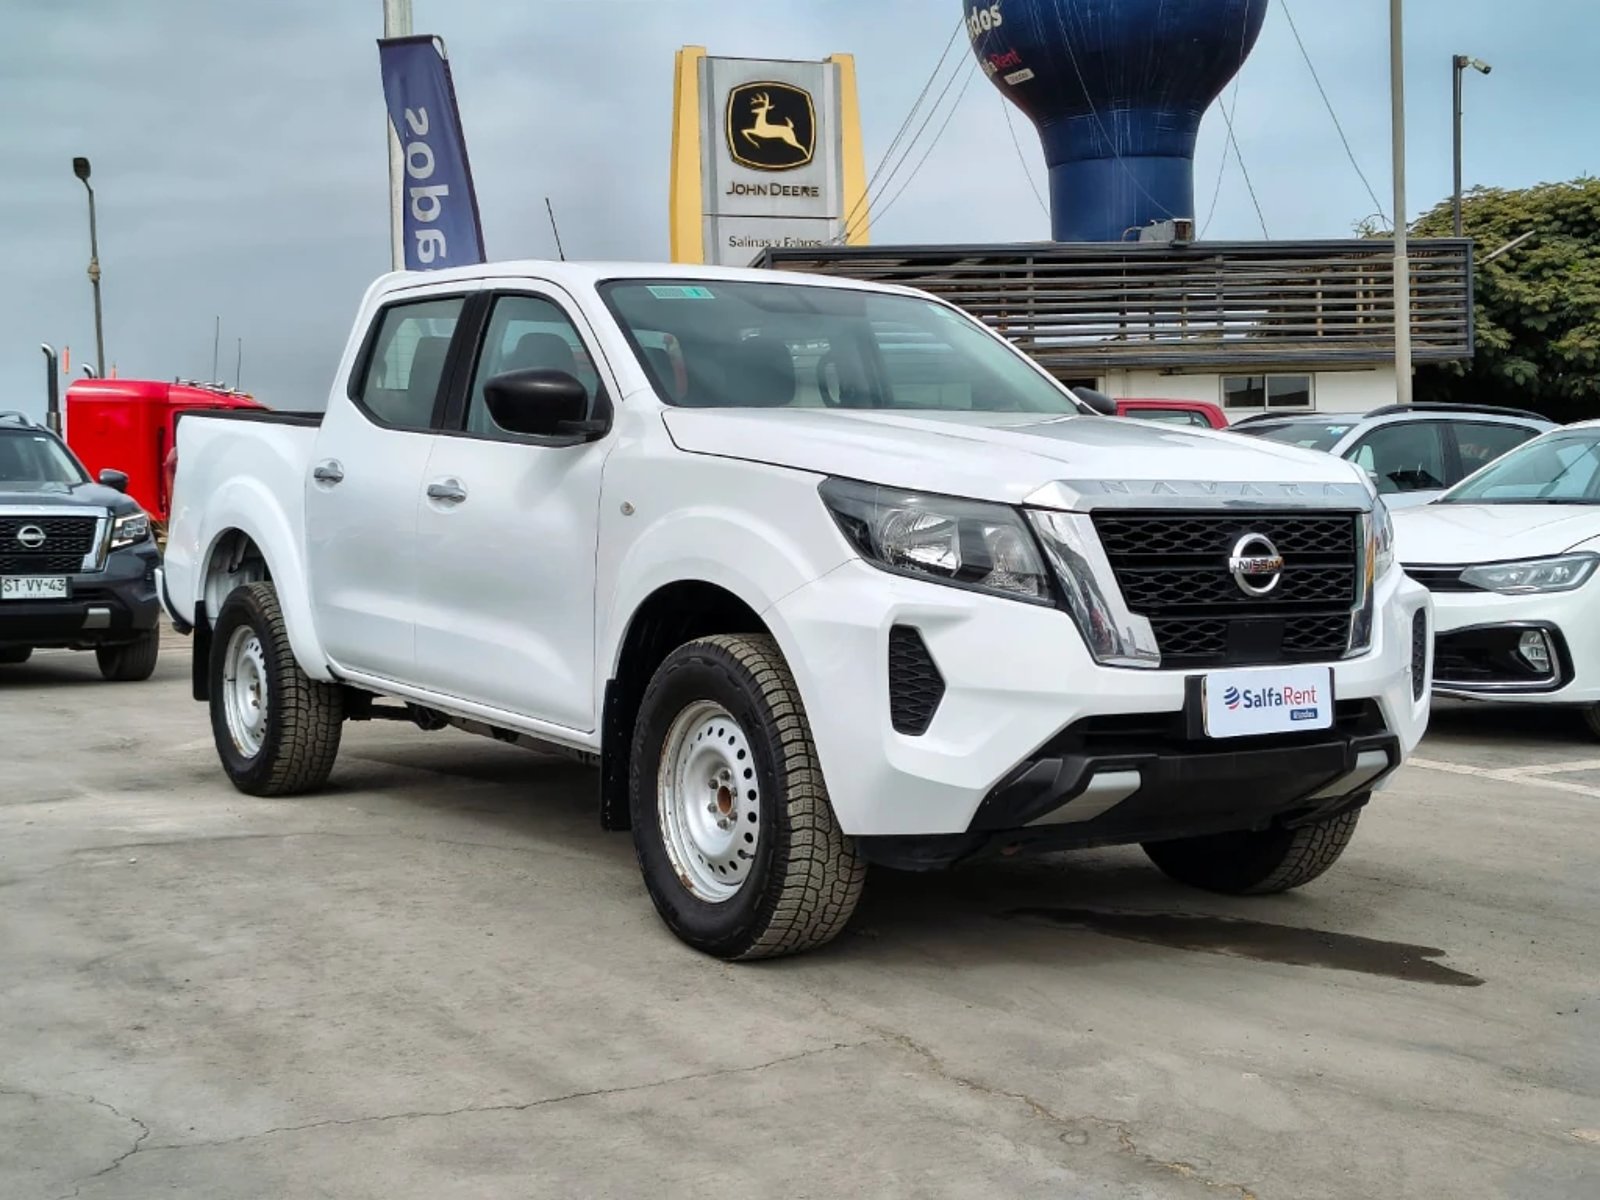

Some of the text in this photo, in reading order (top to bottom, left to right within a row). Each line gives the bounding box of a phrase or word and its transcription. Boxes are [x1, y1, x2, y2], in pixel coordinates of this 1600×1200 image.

[725, 182, 821, 198] JOHN DEERE
[728, 235, 771, 249] Salinas
[1238, 559, 1283, 571] NISSAN
[1242, 685, 1318, 709] SalfaRent
